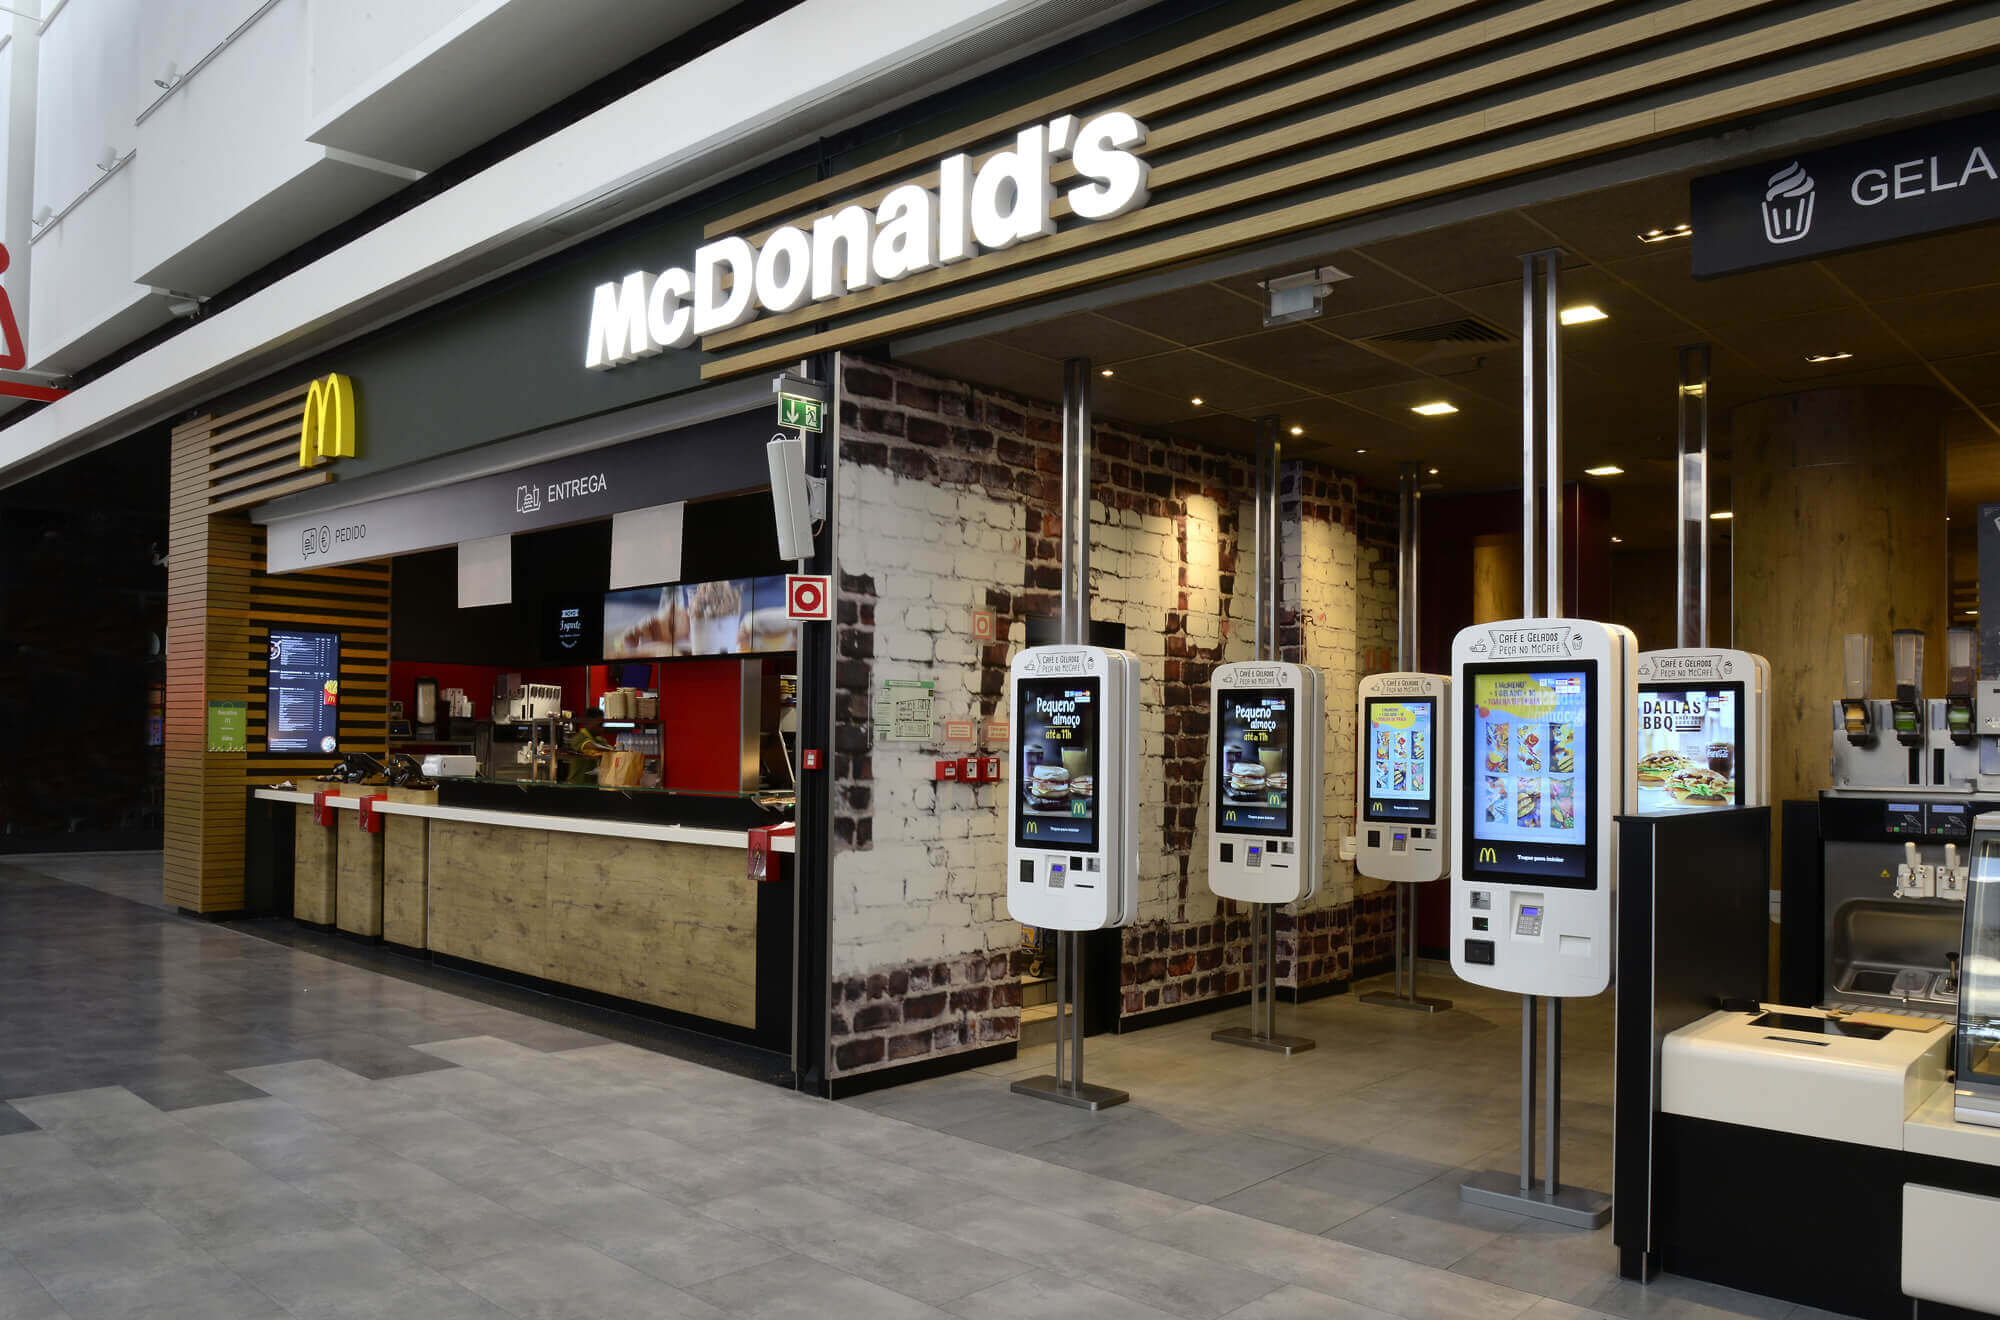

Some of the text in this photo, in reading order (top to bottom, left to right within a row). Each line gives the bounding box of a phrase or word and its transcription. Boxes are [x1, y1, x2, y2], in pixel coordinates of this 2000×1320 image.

[1851, 146, 1999, 206] GELA
[585, 111, 1151, 370] McDonald's
[547, 473, 607, 502] ENTREGA
[335, 524, 367, 544] PEDIDO
[1499, 631, 1559, 643] CAFÉ E GELADOS
[1499, 645, 1517, 656] PEÇA
[1519, 644, 1529, 654] NO
[1660, 658, 1677, 668] CAFÉ
[1684, 659, 1712, 668] GELADOS
[1660, 669, 1675, 678] PEÇA
[1677, 669, 1686, 677] NO
[1036, 697, 1076, 717] Pequeno
[1235, 705, 1272, 722] Pequeno
[1643, 700, 1701, 715] DALLAS
[1052, 712, 1081, 728] almoço
[1250, 718, 1277, 732] almoço
[1643, 716, 1673, 732] BBQ
[1045, 729, 1056, 740] até
[1061, 728, 1072, 740] 11h
[1243, 732, 1254, 742] até
